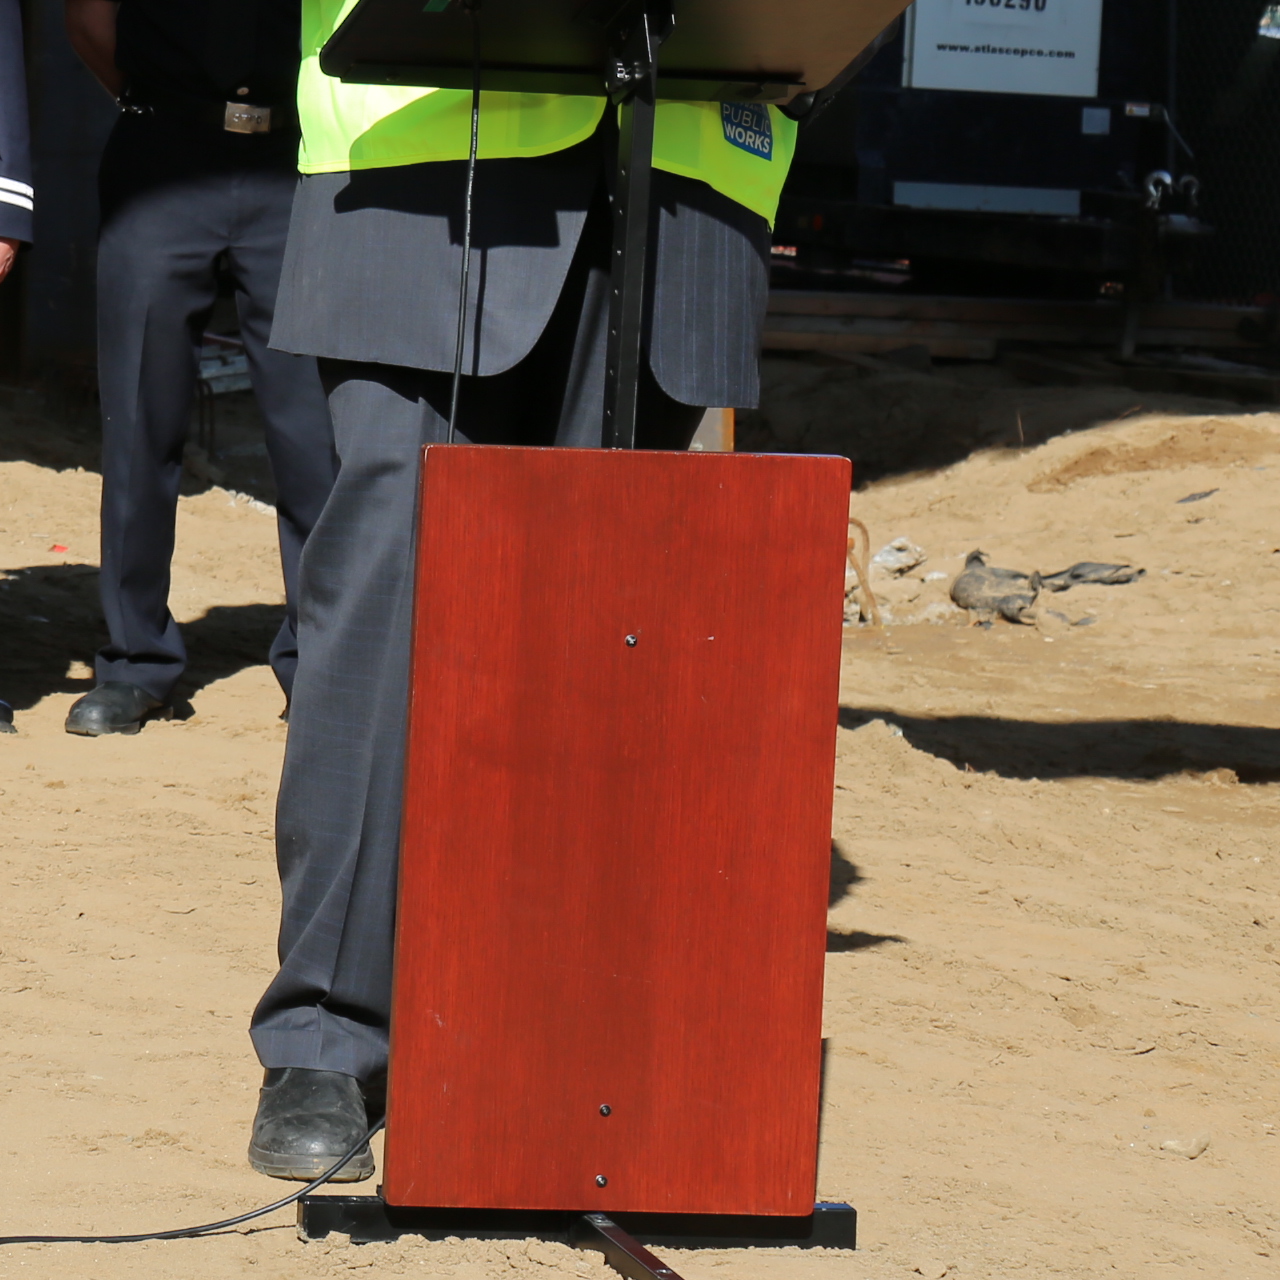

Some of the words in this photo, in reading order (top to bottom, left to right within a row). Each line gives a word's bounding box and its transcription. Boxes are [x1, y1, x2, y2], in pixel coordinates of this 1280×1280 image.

[936, 42, 1076, 59] www.atlascopco.com
[723, 103, 771, 136] PUBLIC
[724, 120, 771, 154] WORKS
